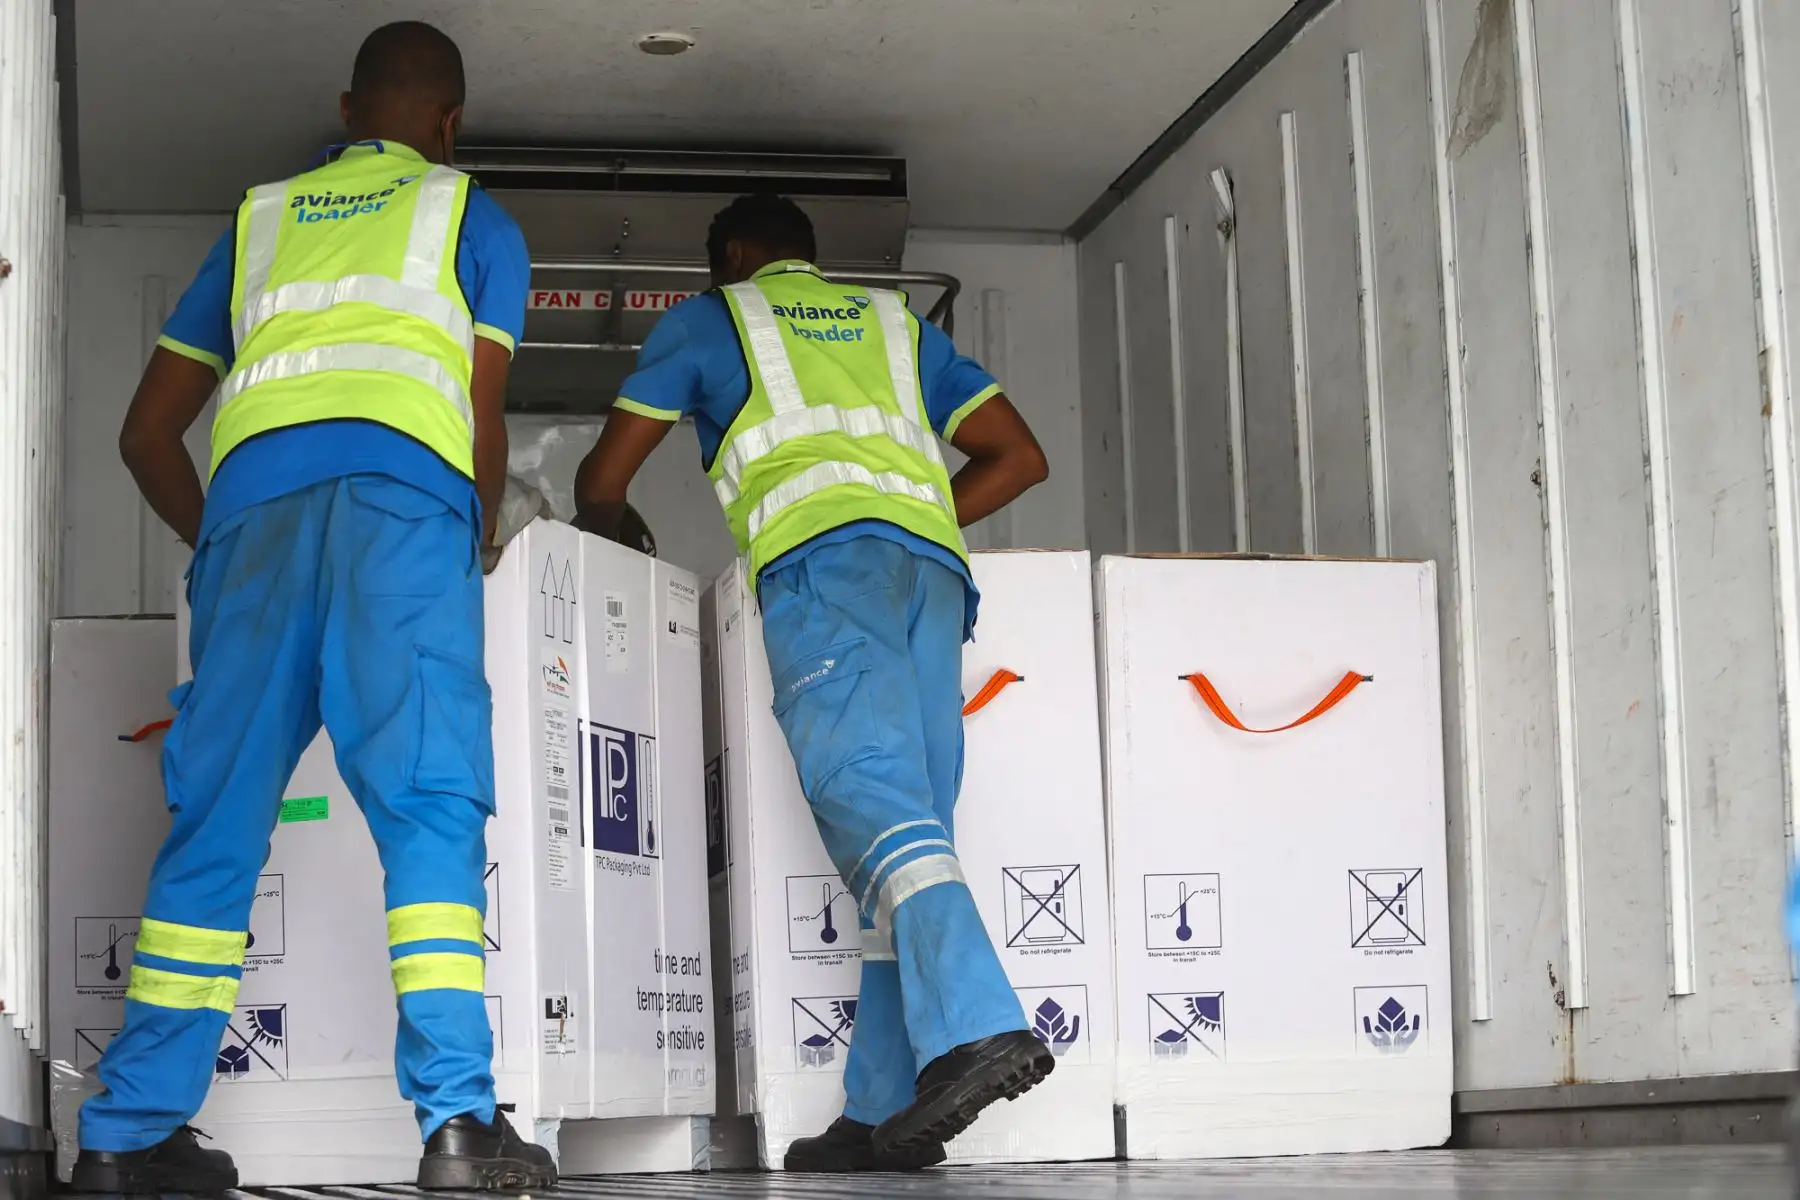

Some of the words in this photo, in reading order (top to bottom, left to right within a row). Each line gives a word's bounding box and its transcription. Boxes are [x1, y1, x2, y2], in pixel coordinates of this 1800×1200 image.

[290, 190, 396, 208] aviance
[296, 200, 388, 224] loader
[533, 291, 582, 308] FAN
[594, 292, 696, 309] CUTIO
[771, 301, 861, 320] aviance
[788, 322, 865, 342] loader
[791, 668, 829, 693] aviance
[606, 857, 633, 877] Packaging
[654, 948, 678, 975] time
[681, 952, 702, 976] and
[636, 985, 704, 1018] temperature
